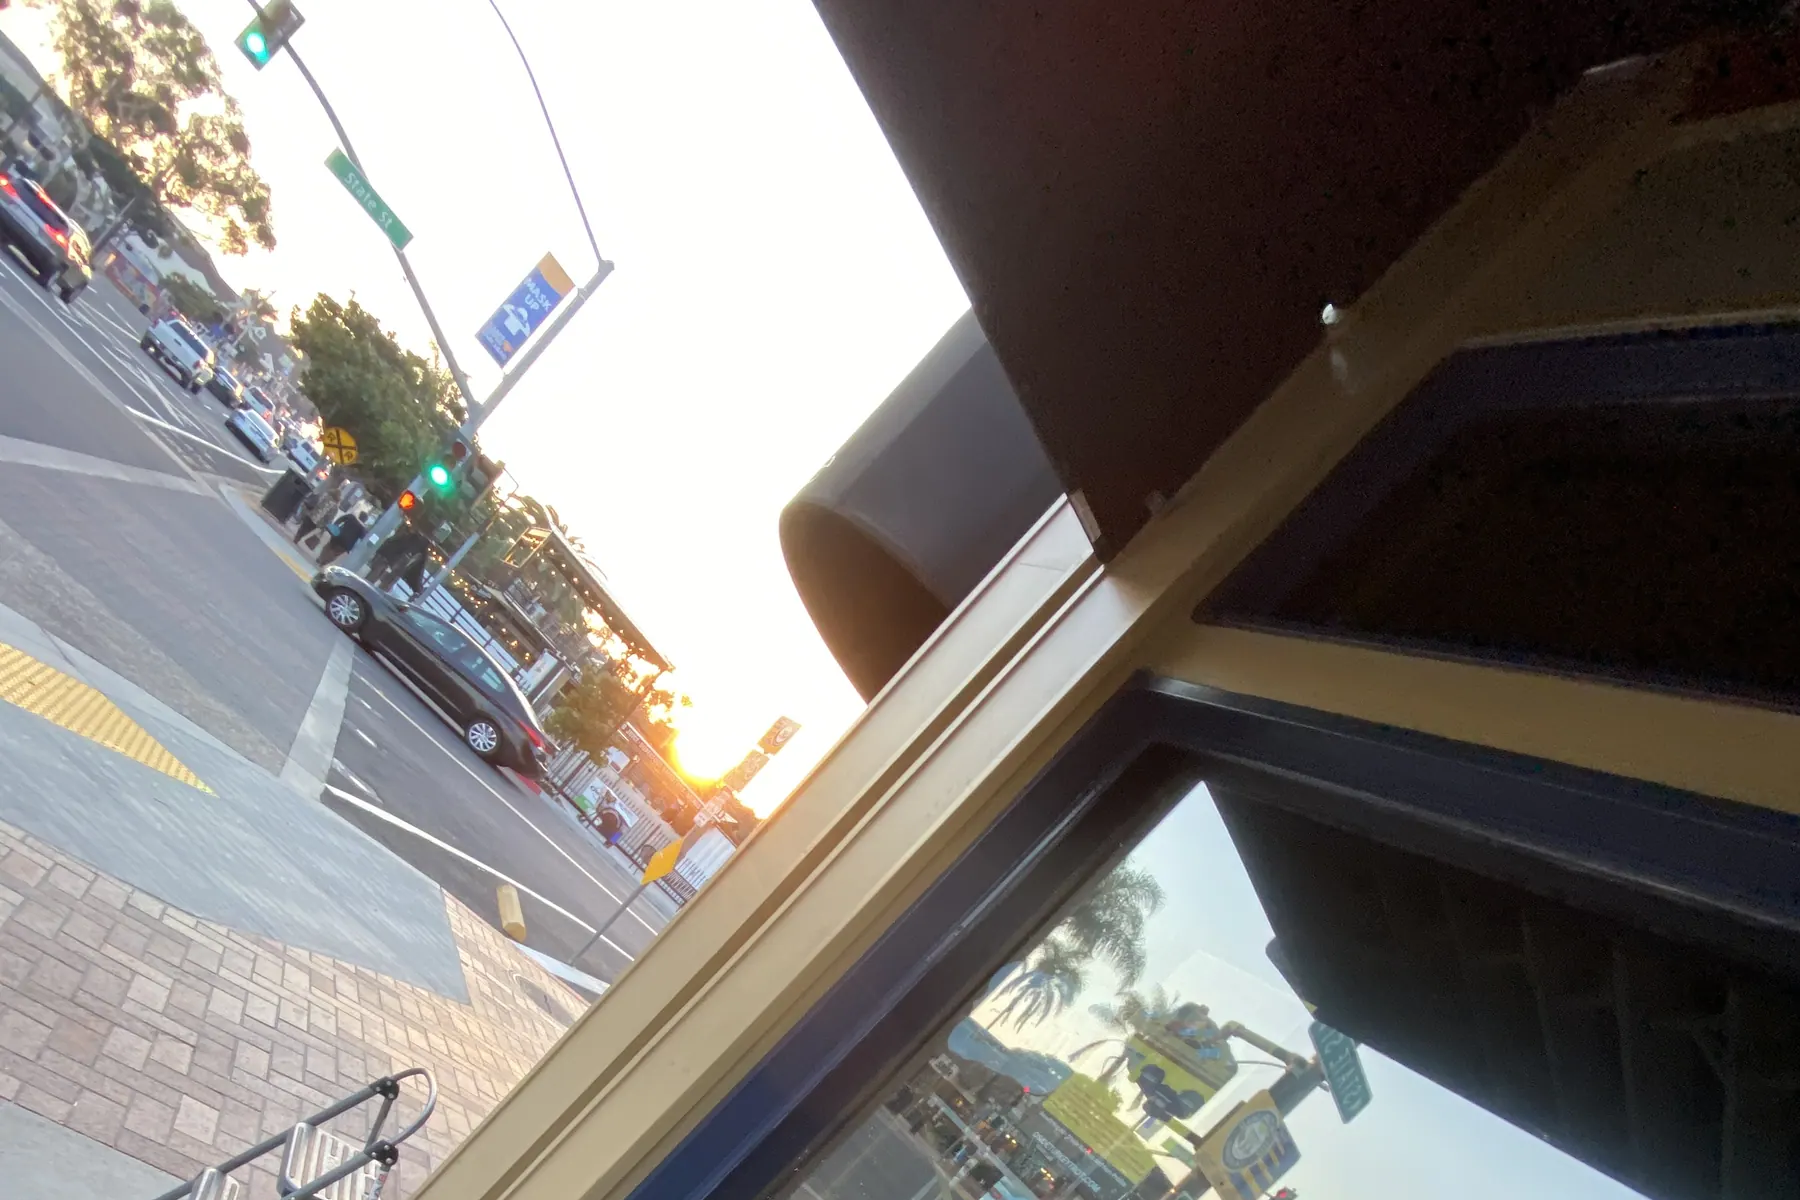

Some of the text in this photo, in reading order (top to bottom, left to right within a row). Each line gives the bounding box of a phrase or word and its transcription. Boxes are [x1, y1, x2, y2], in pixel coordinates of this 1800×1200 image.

[344, 172, 393, 229] State St
[523, 277, 552, 312] MASK
[525, 294, 540, 311] UP
